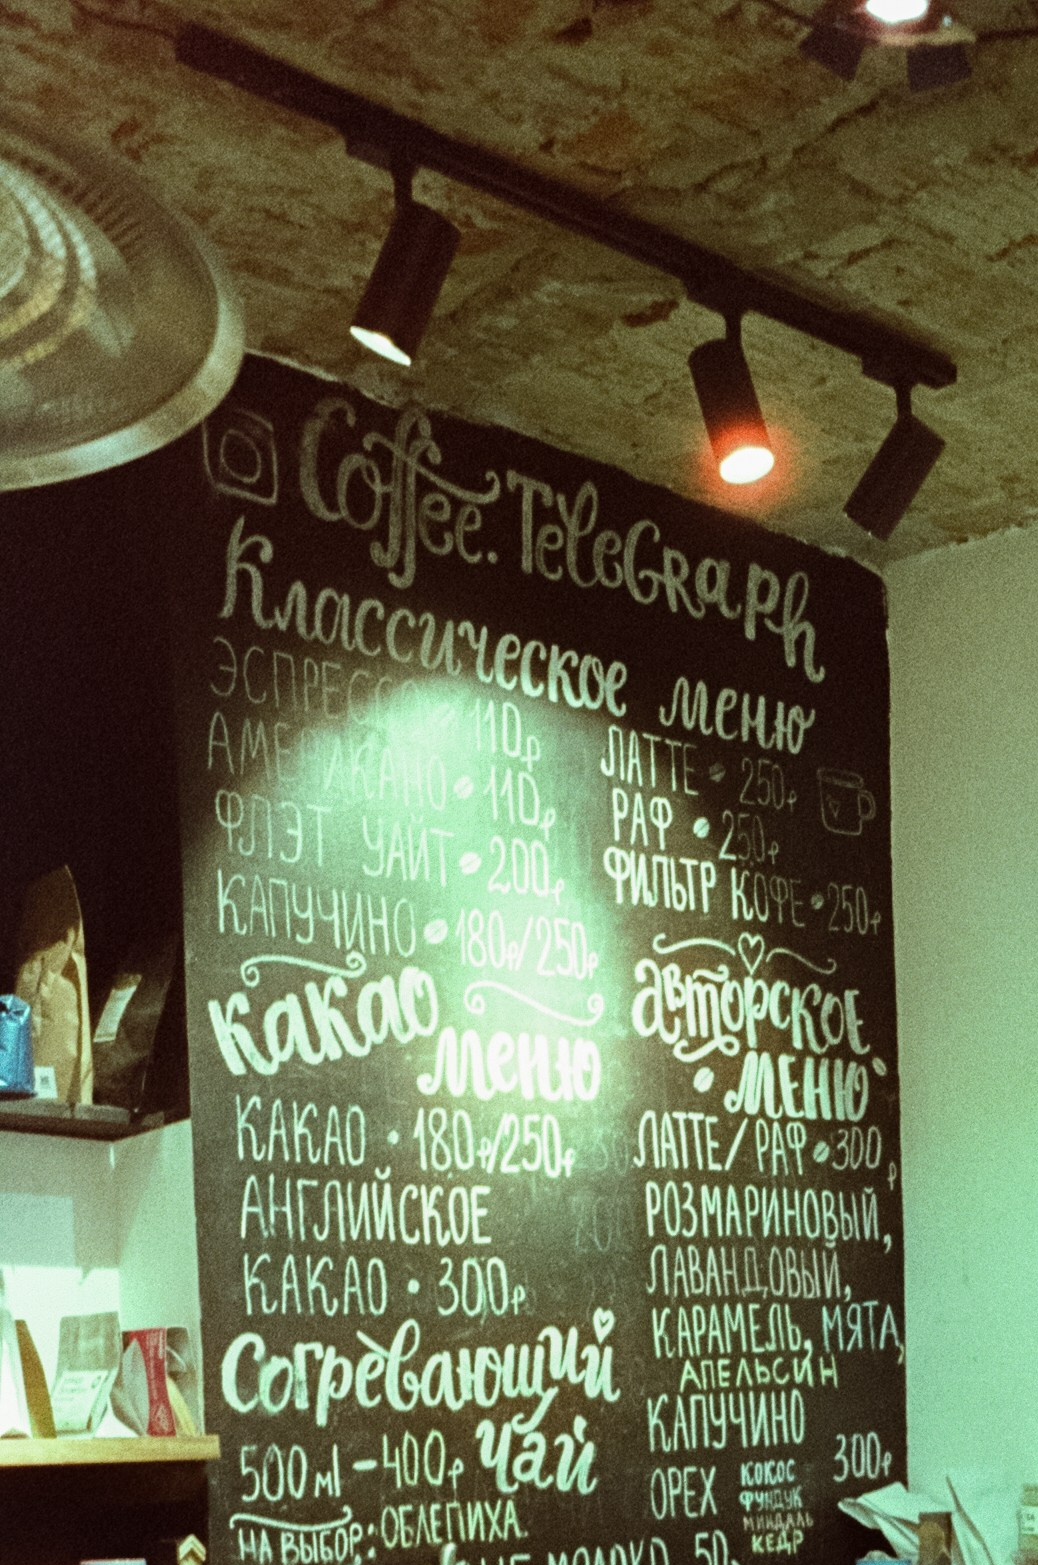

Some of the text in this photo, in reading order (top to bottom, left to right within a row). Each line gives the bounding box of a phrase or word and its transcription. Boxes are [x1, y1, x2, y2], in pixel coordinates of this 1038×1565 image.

[218, 515, 627, 717] Классическое
[207, 711, 448, 812] АМЕРИКАНО
[601, 724, 699, 796] ЛАТТЕ
[215, 789, 333, 868] ФЛЭТ
[362, 812, 455, 888] УАЙТ
[612, 787, 674, 851] РАФ
[216, 868, 417, 958] КАПУЧИНО
[603, 846, 717, 914] ФИЛЬТР
[731, 866, 805, 928] КОФЕ
[723, 1050, 870, 1123] МЕНЮ
[235, 1094, 366, 1167] КАКАО
[239, 1166, 492, 1247] АНГЛИЙСКОЕ
[243, 1253, 388, 1317] КАКАО
[221, 1308, 620, 1435] Согревающий
[679, 1353, 839, 1393] АПЕЛЬСИН
[646, 1388, 805, 1453] КАПУЧИНО
[650, 1465, 718, 1521] ОРЕХ
[739, 1484, 804, 1513] ФУНДУК
[741, 1458, 797, 1488] КОКОС
[238, 1527, 273, 1565] НА
[742, 1511, 815, 1533] МИНДАЛЬ
[751, 1527, 805, 1557] КЕДР
